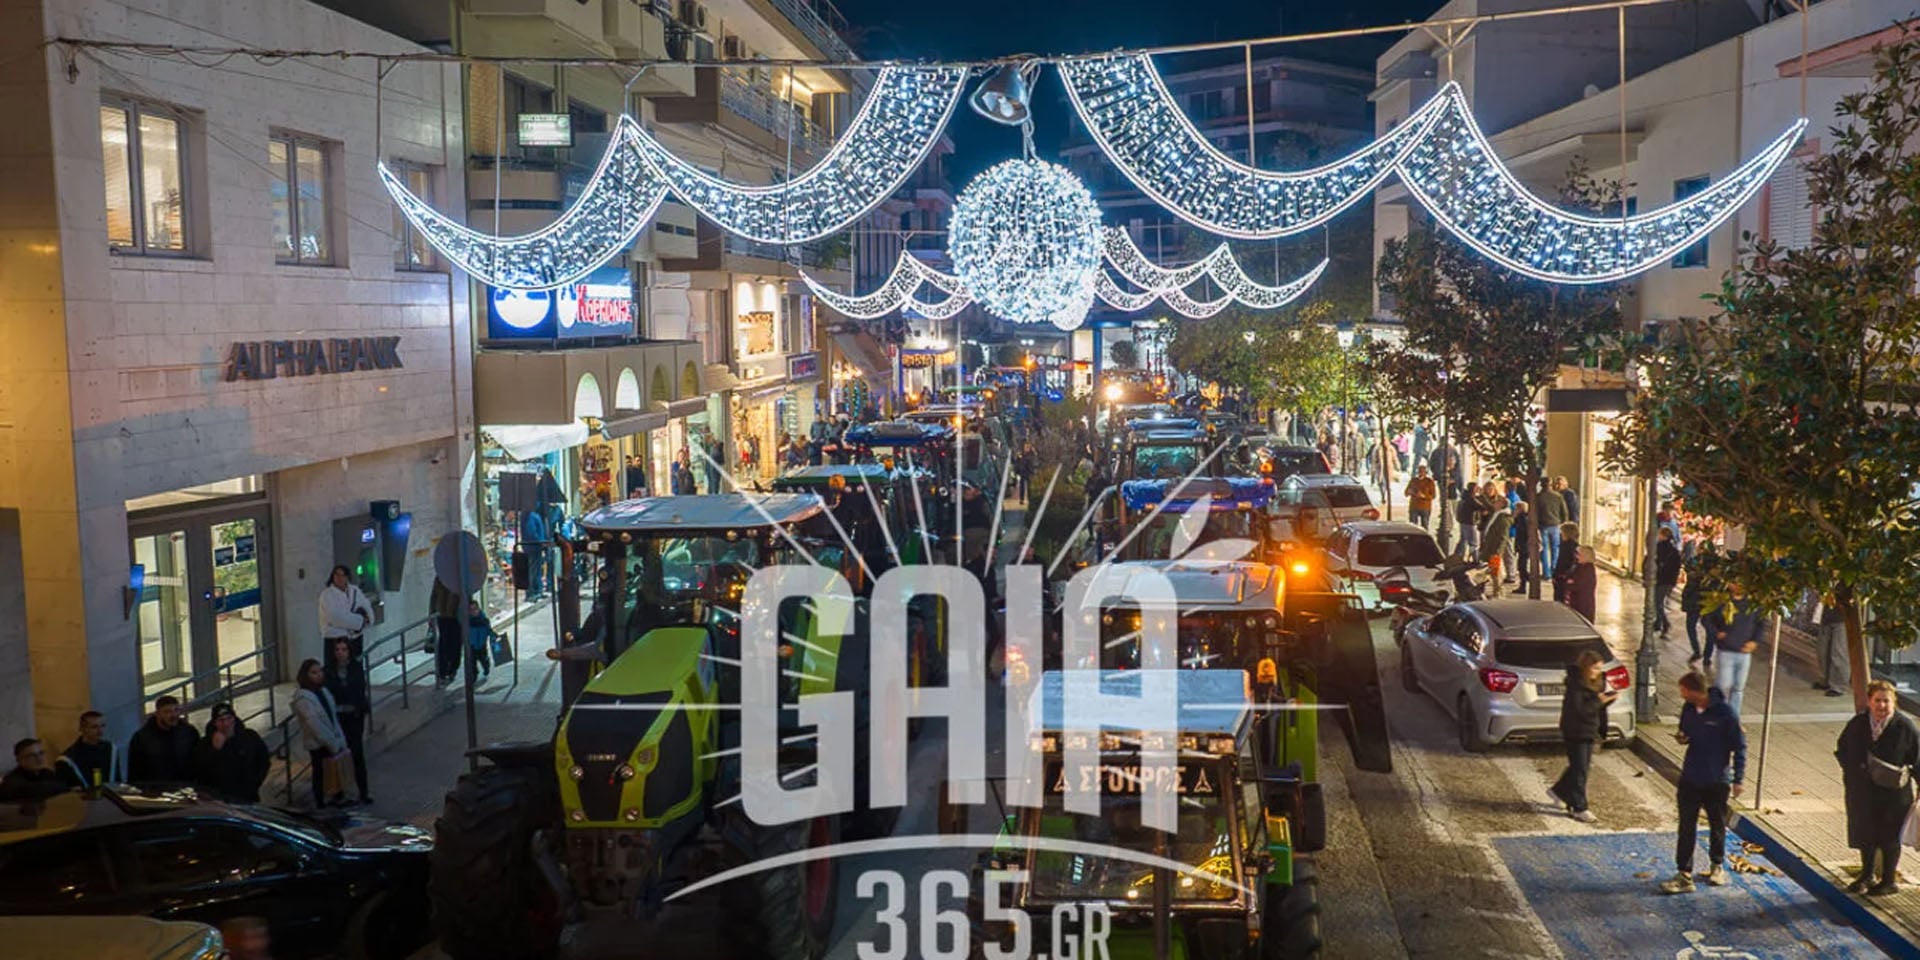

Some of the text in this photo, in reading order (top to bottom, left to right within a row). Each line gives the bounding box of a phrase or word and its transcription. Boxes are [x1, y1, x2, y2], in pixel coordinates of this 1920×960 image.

[226, 336, 403, 382] ALPHA BANK
[1079, 765, 1187, 793] ΣΓΟΥΡΟΣ
